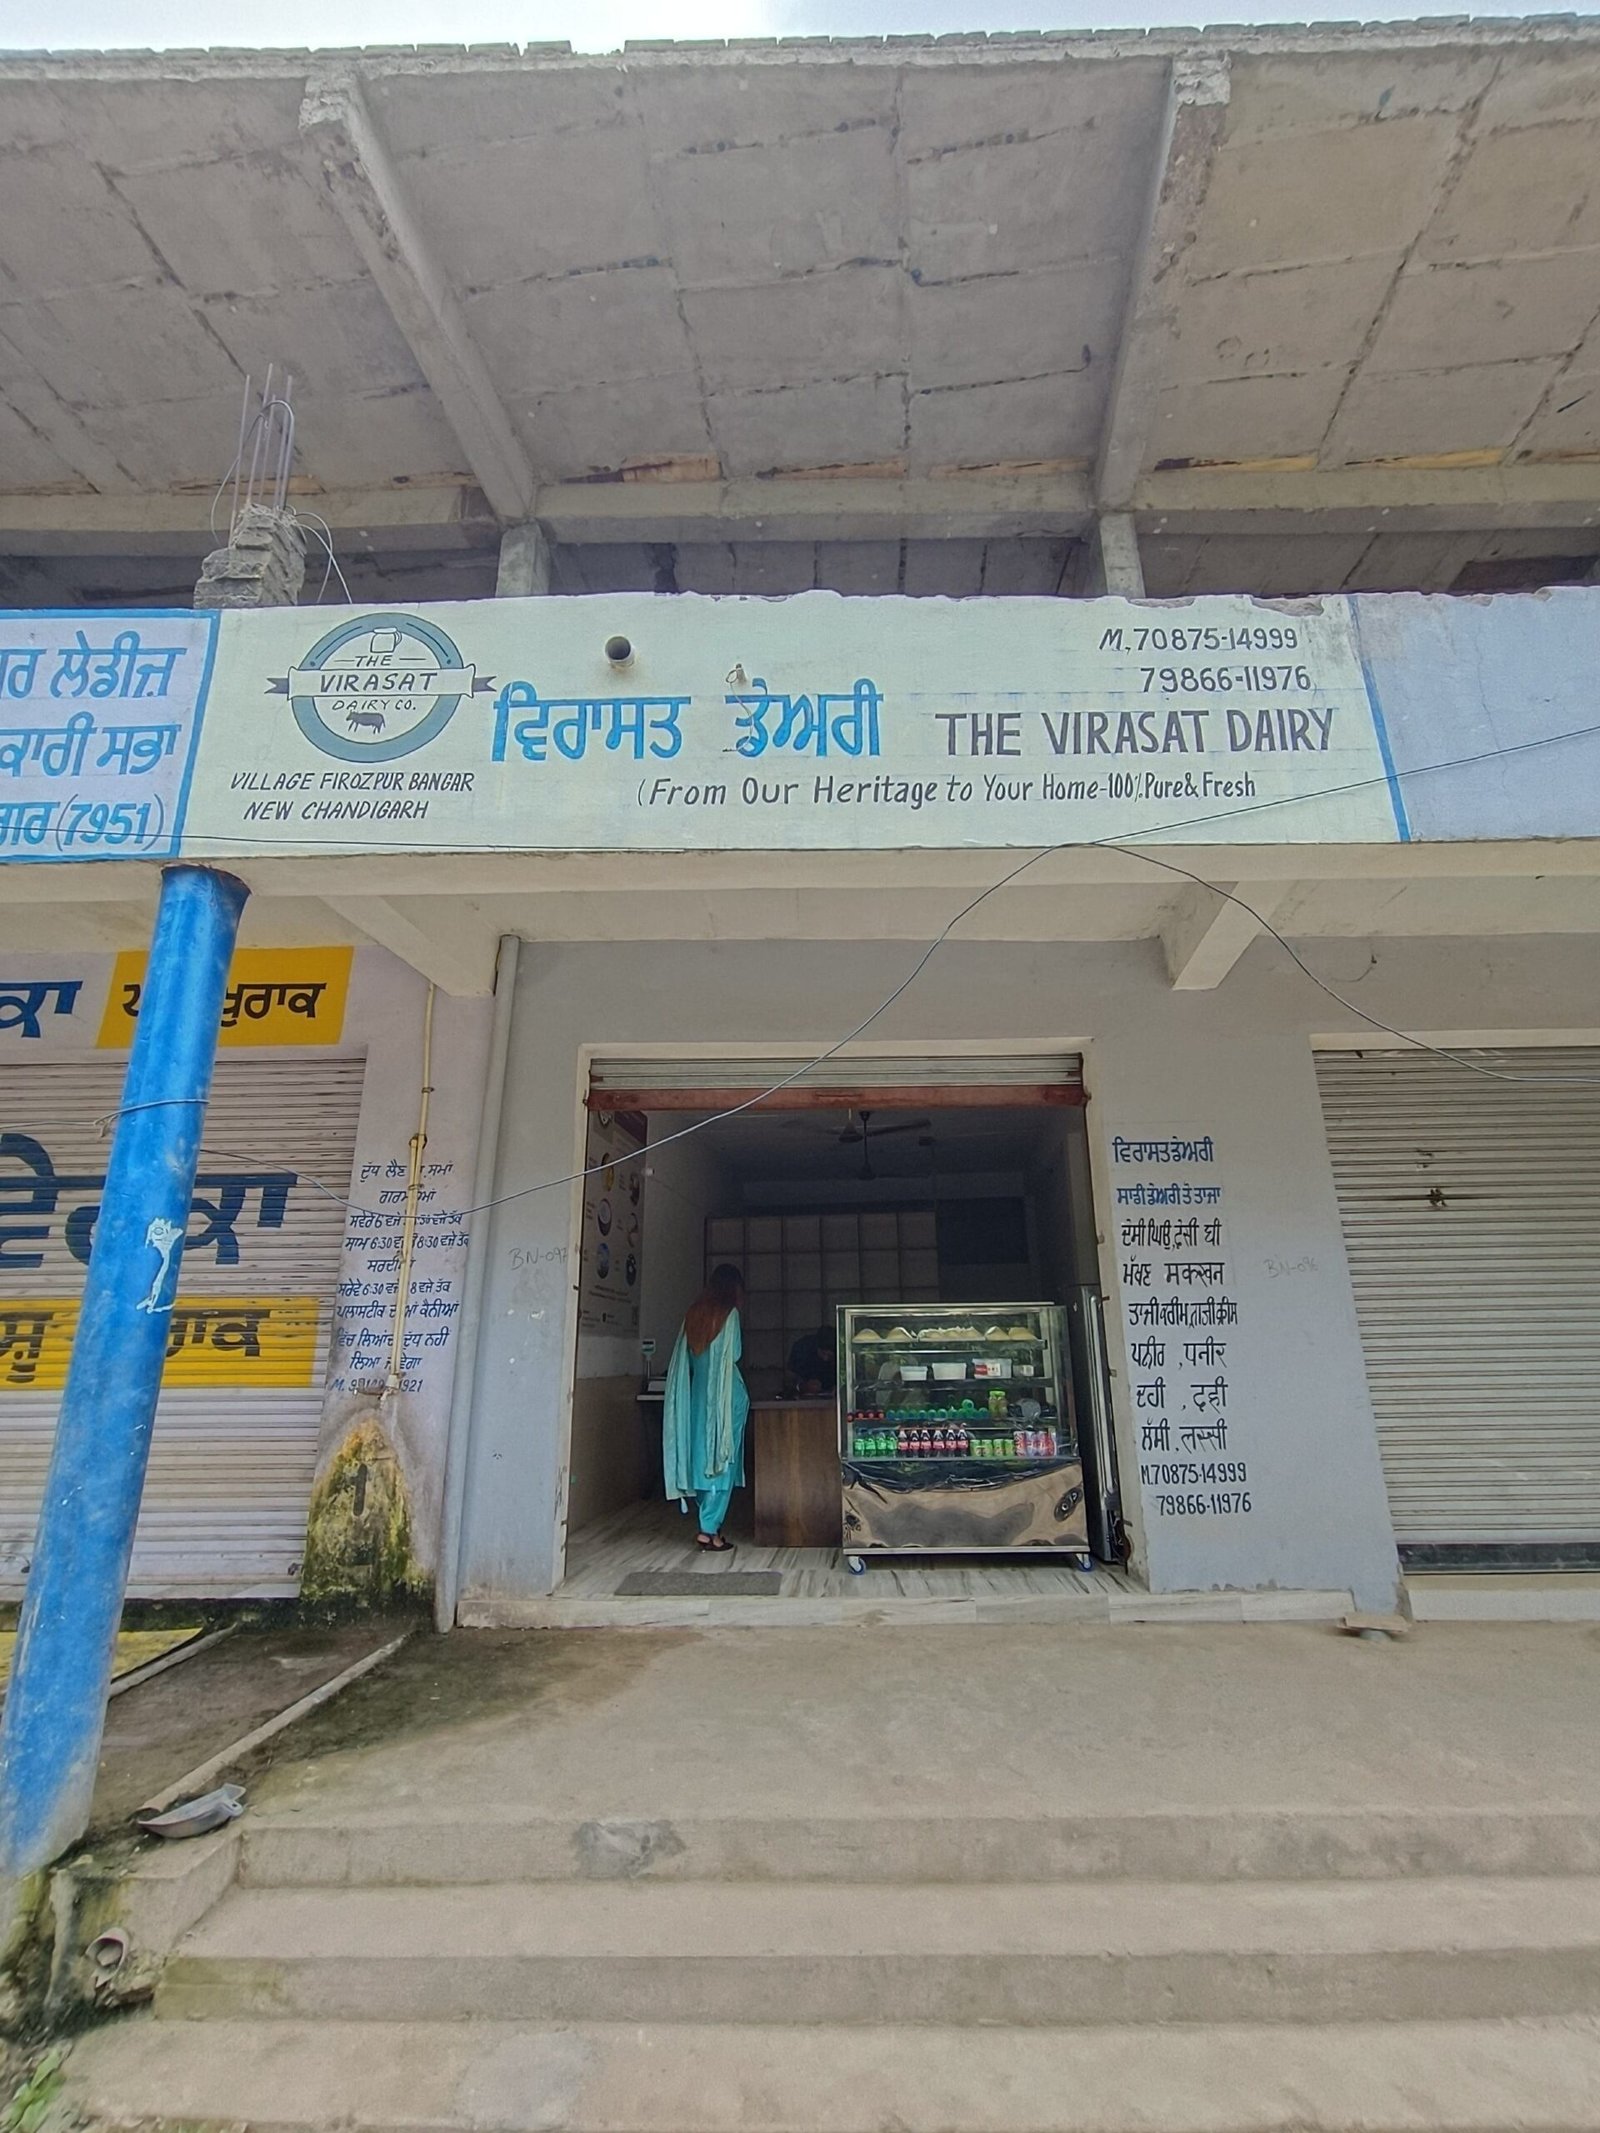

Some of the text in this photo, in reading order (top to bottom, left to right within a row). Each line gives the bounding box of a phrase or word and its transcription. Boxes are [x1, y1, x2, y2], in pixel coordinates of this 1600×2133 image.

[353, 655, 394, 667] THE
[320, 673, 438, 692] VIRASAT
[1139, 666, 1311, 693] 79866-11976
[332, 699, 416, 711] DAIRY CO.
[491, 678, 884, 761] ਵਿਰਾਸਤ ਡੇਅਰੀ
[935, 708, 1334, 756] THE VIRASAT DAIRY
[97, 724, 182, 775] ਸਭਾ
[231, 772, 475, 791] VILLAGE FIROZPUR BANGAR
[637, 777, 727, 806] (From
[741, 777, 798, 805] Our
[813, 776, 937, 809] Heritage
[946, 777, 973, 802] to
[984, 775, 1034, 801] Your
[1203, 771, 1256, 798] Fresh
[56, 793, 164, 852] (7951)
[243, 800, 429, 820] NEW CHANDIGARH
[1204, 1217, 1222, 1246] घी
